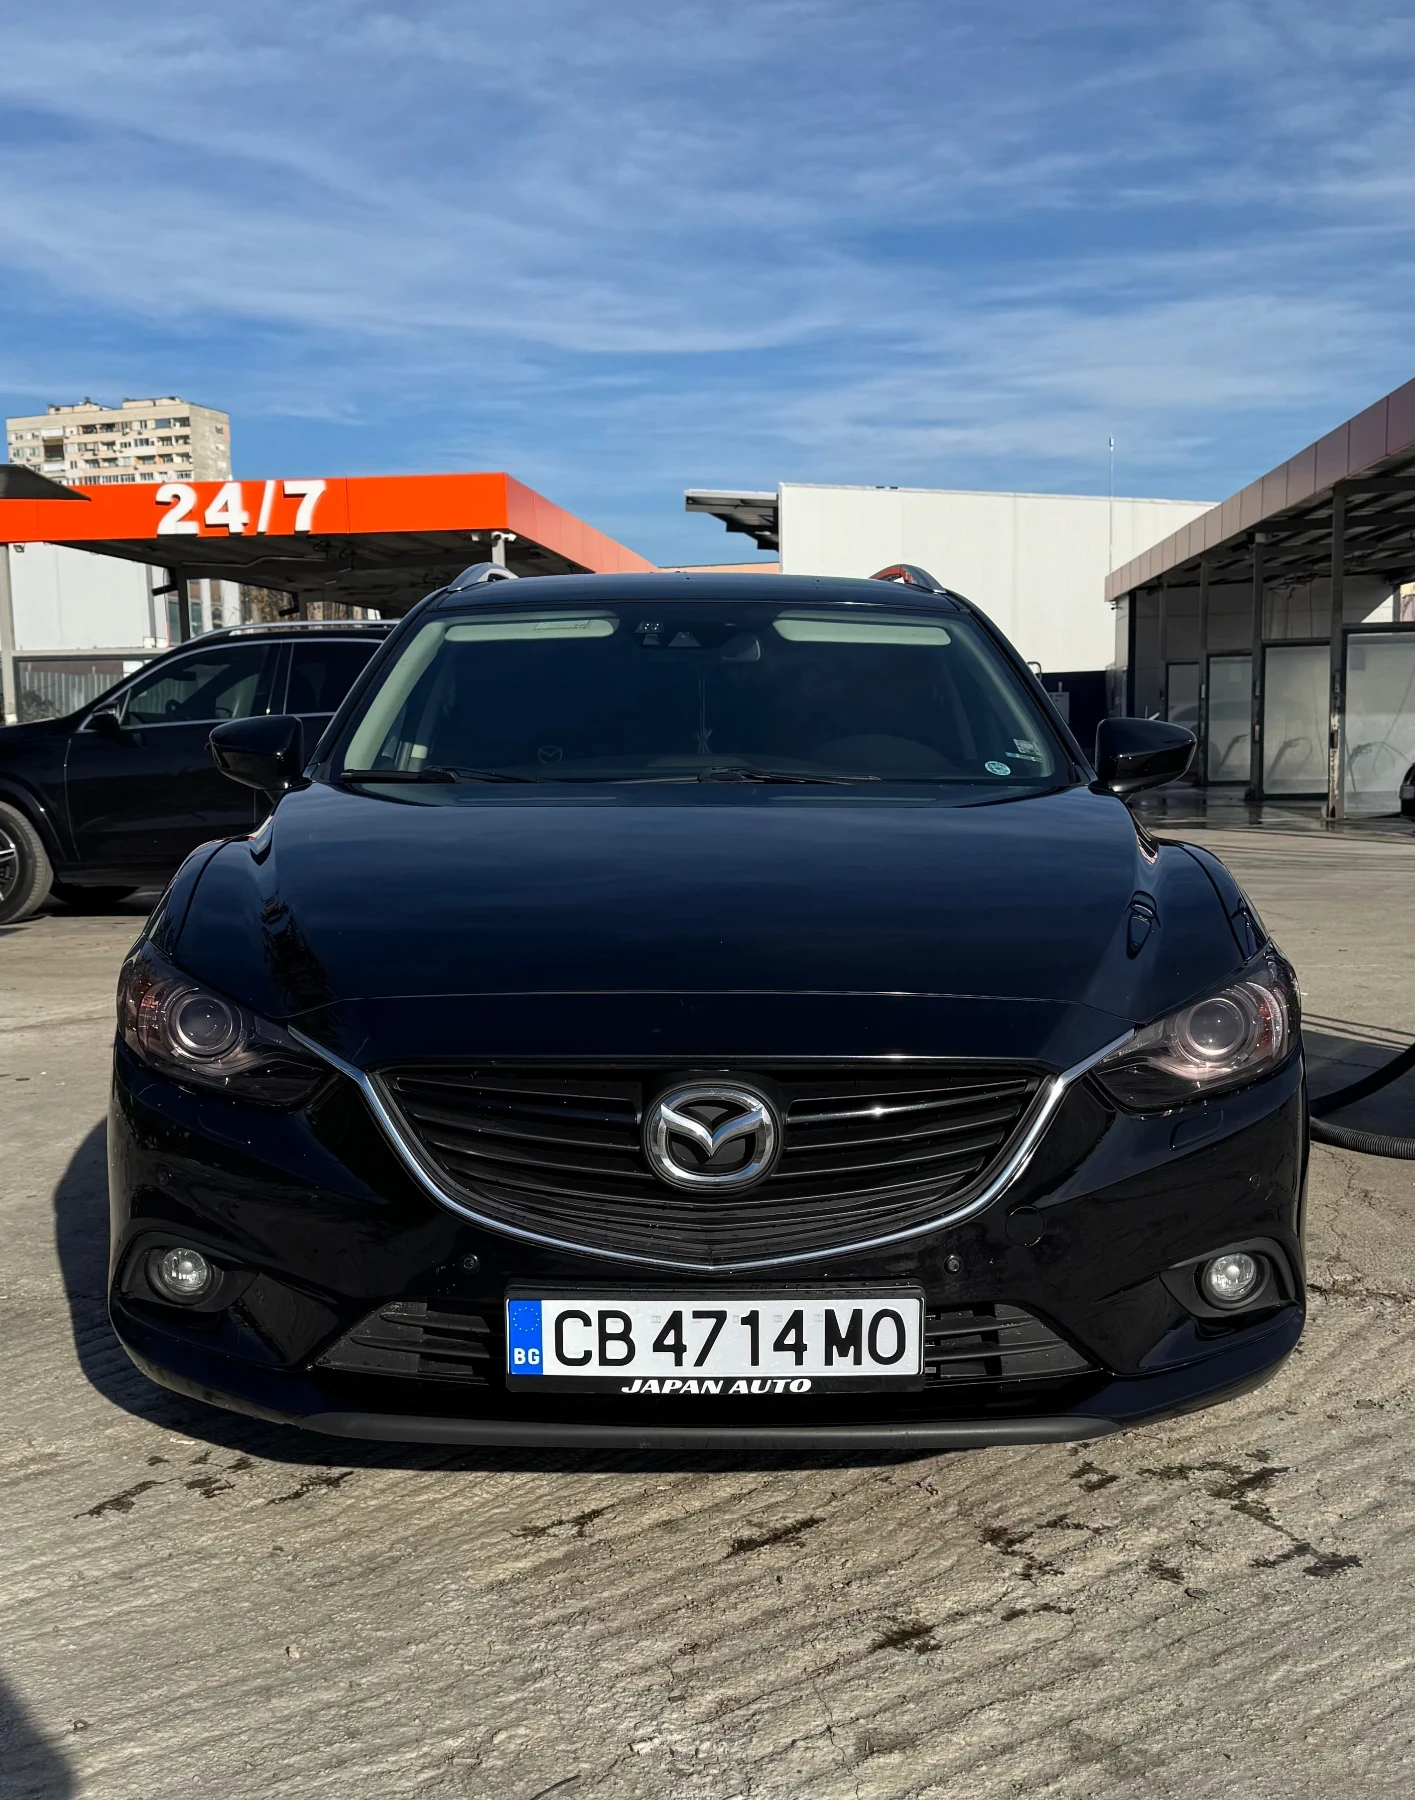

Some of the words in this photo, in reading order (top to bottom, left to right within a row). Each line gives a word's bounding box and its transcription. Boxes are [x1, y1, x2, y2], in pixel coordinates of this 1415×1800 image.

[155, 480, 326, 534] 24/7
[554, 1309, 636, 1367] CB
[652, 1310, 808, 1367] 4714
[824, 1308, 906, 1367] MO
[514, 1348, 540, 1365] BG
[621, 1379, 724, 1394] JAPAN
[728, 1378, 812, 1394] AUTO
